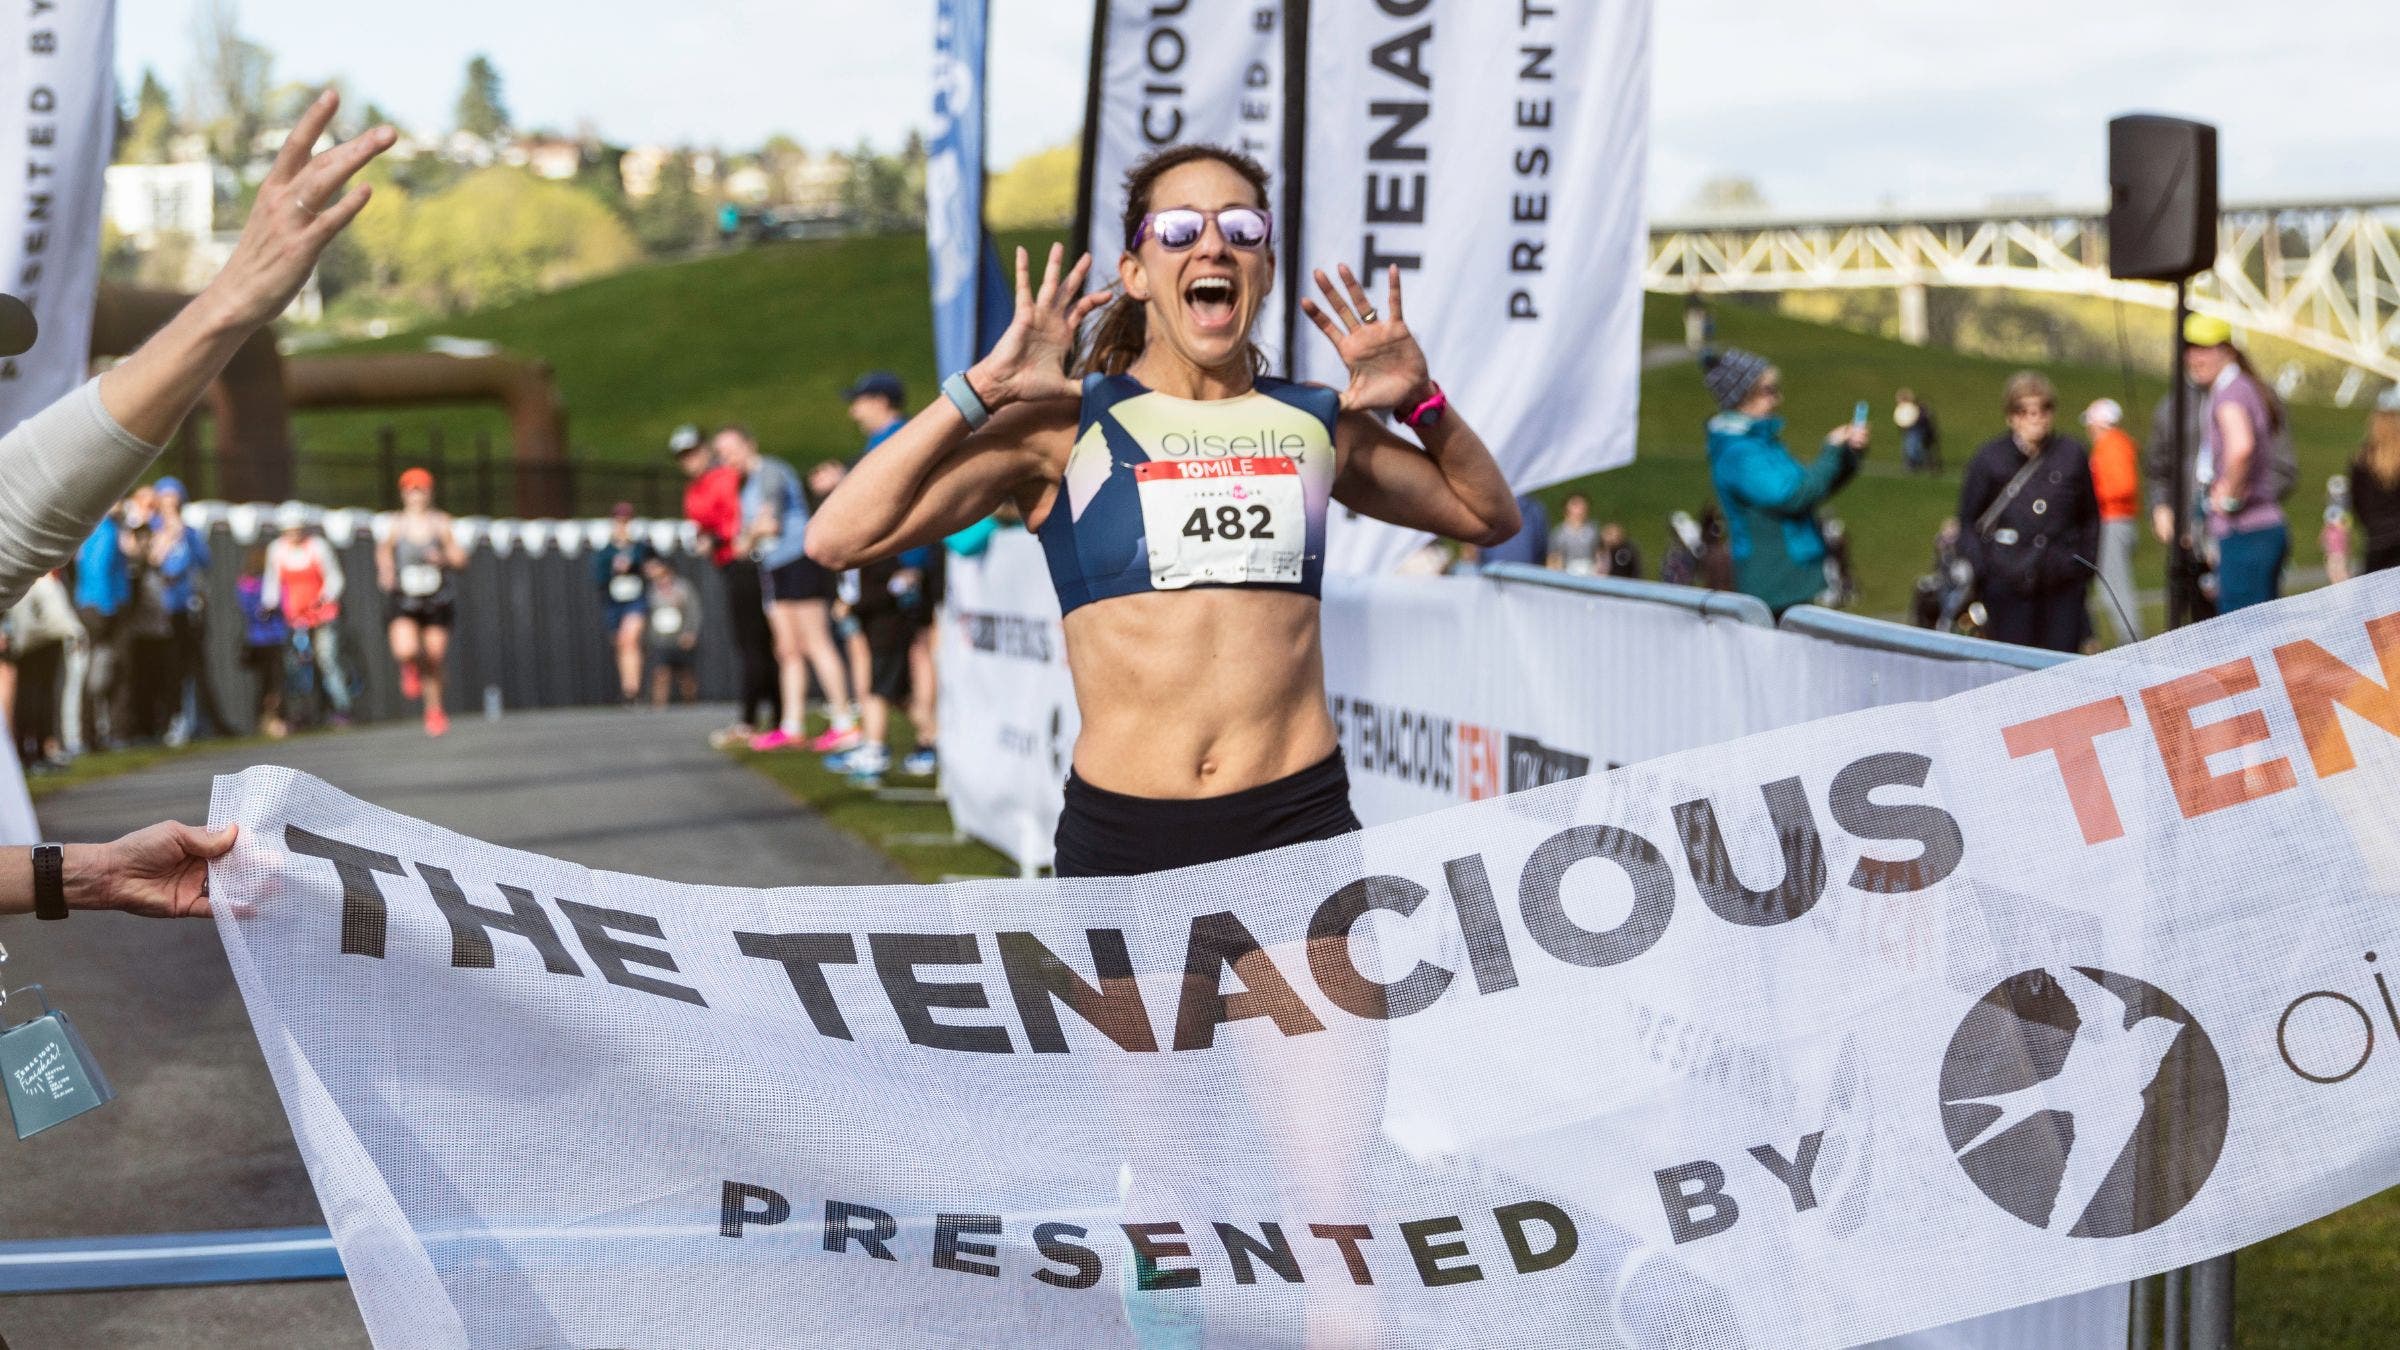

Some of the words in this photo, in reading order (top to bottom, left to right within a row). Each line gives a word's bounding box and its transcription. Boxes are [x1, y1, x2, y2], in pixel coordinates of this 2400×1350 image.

[1162, 430, 1305, 460] oiselle
[1182, 504, 1274, 542] 482
[284, 824, 709, 1008] THE
[732, 751, 1965, 1054] TENACIOUS
[719, 1180, 1579, 1291] PRESENTED
[1653, 1129, 1825, 1246] BY
